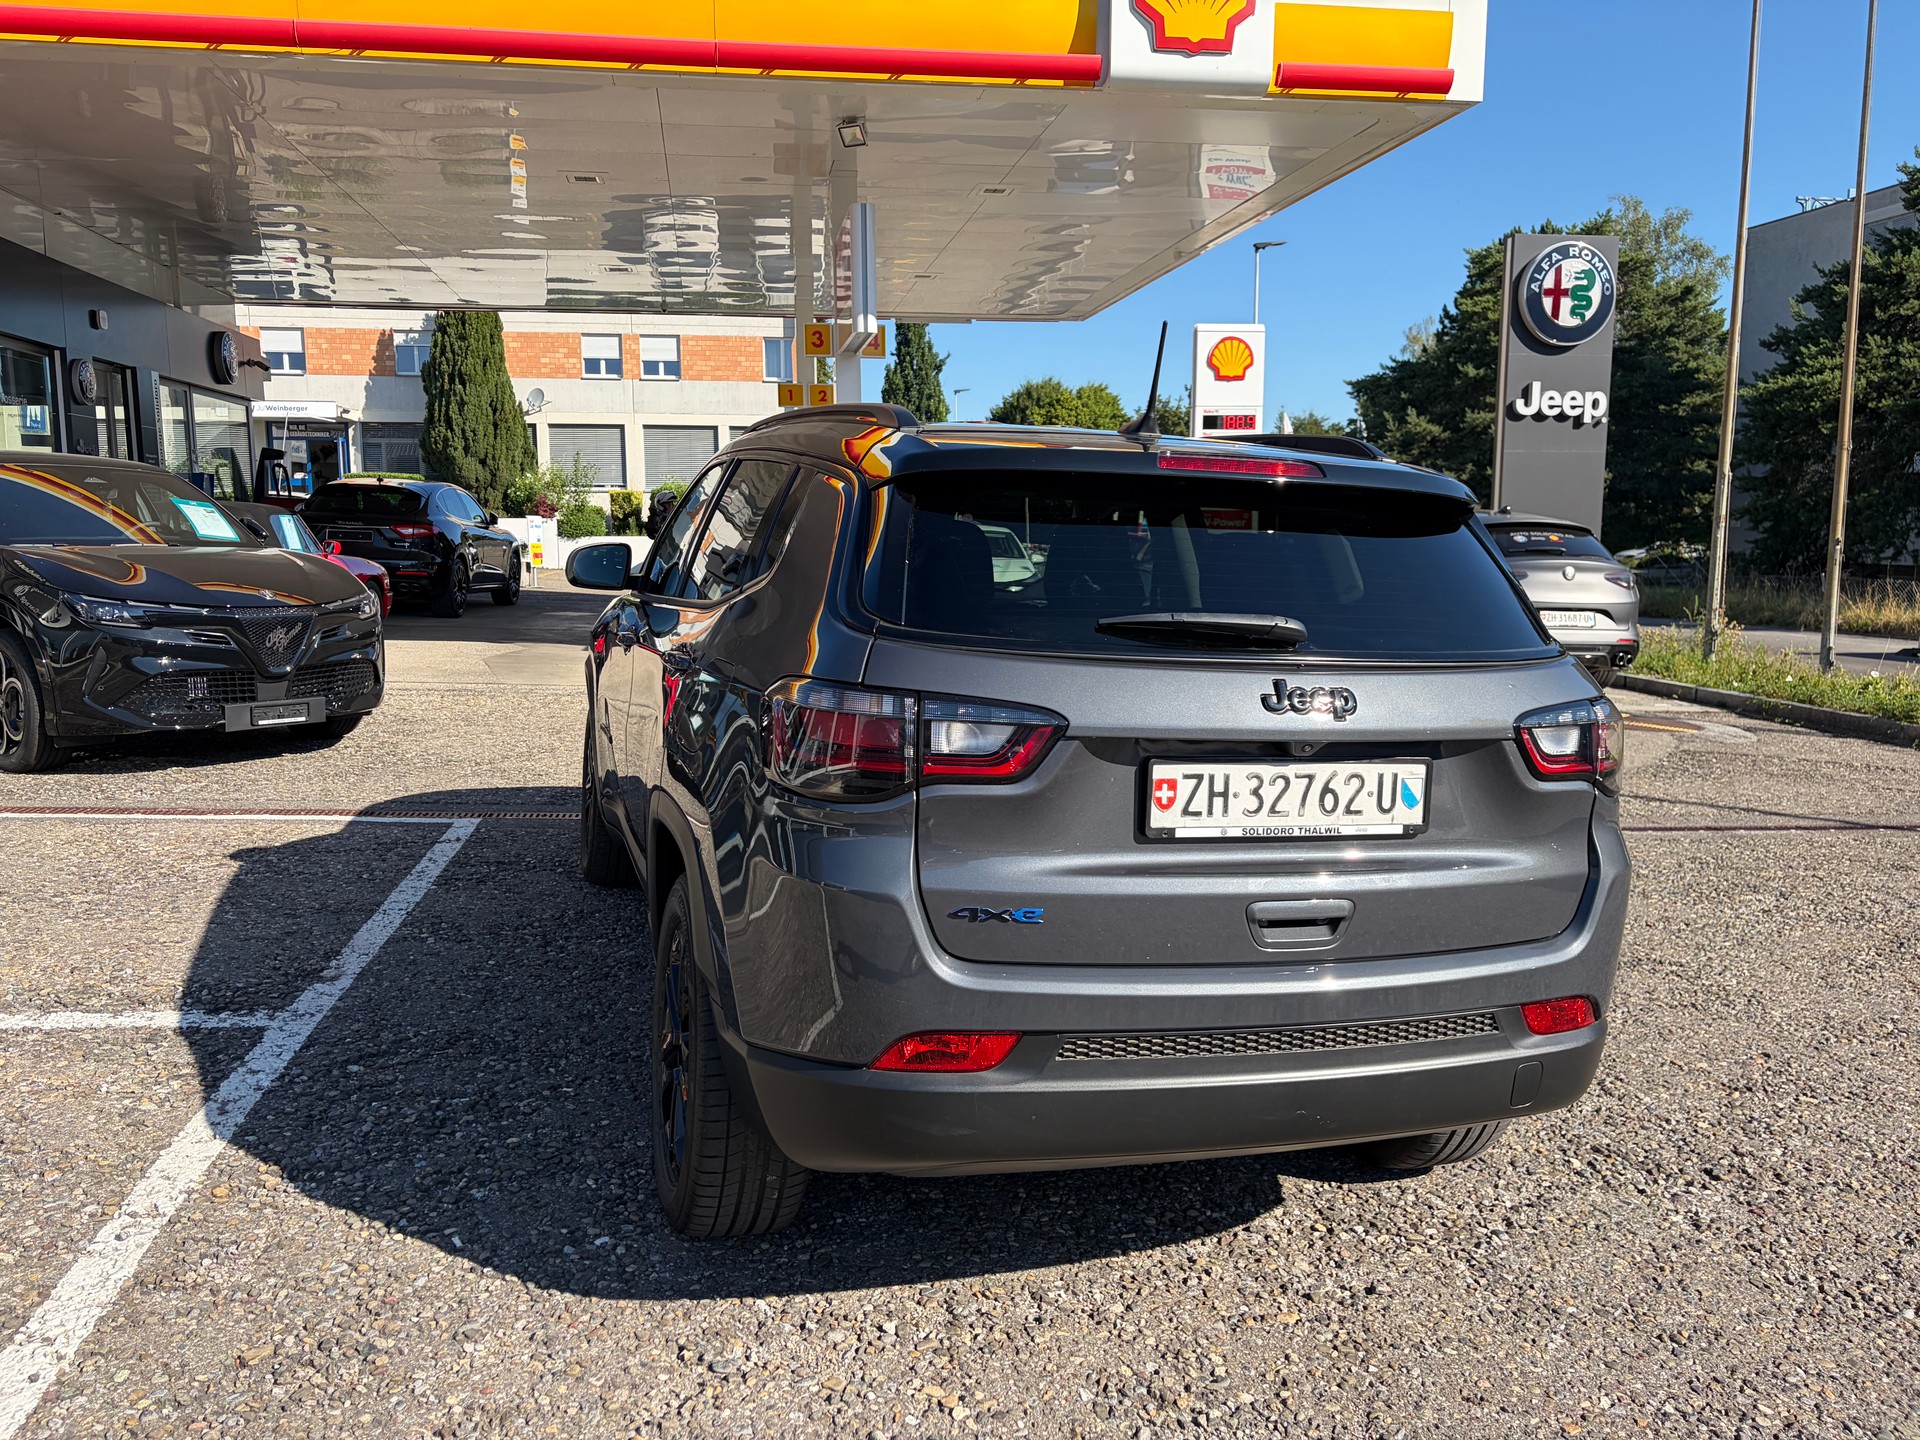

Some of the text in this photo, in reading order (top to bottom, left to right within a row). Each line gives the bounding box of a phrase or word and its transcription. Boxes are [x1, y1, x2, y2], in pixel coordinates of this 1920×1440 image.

[1530, 246, 1612, 296] ALFA ROMEO
[811, 330, 825, 349] 3
[787, 389, 793, 402] 1
[817, 390, 828, 402] 2
[1203, 517, 1247, 527] V-Power
[1260, 678, 1358, 722] Jeep
[1241, 827, 1295, 837] SOLIDORO
[1297, 826, 1343, 836] THALWIL
